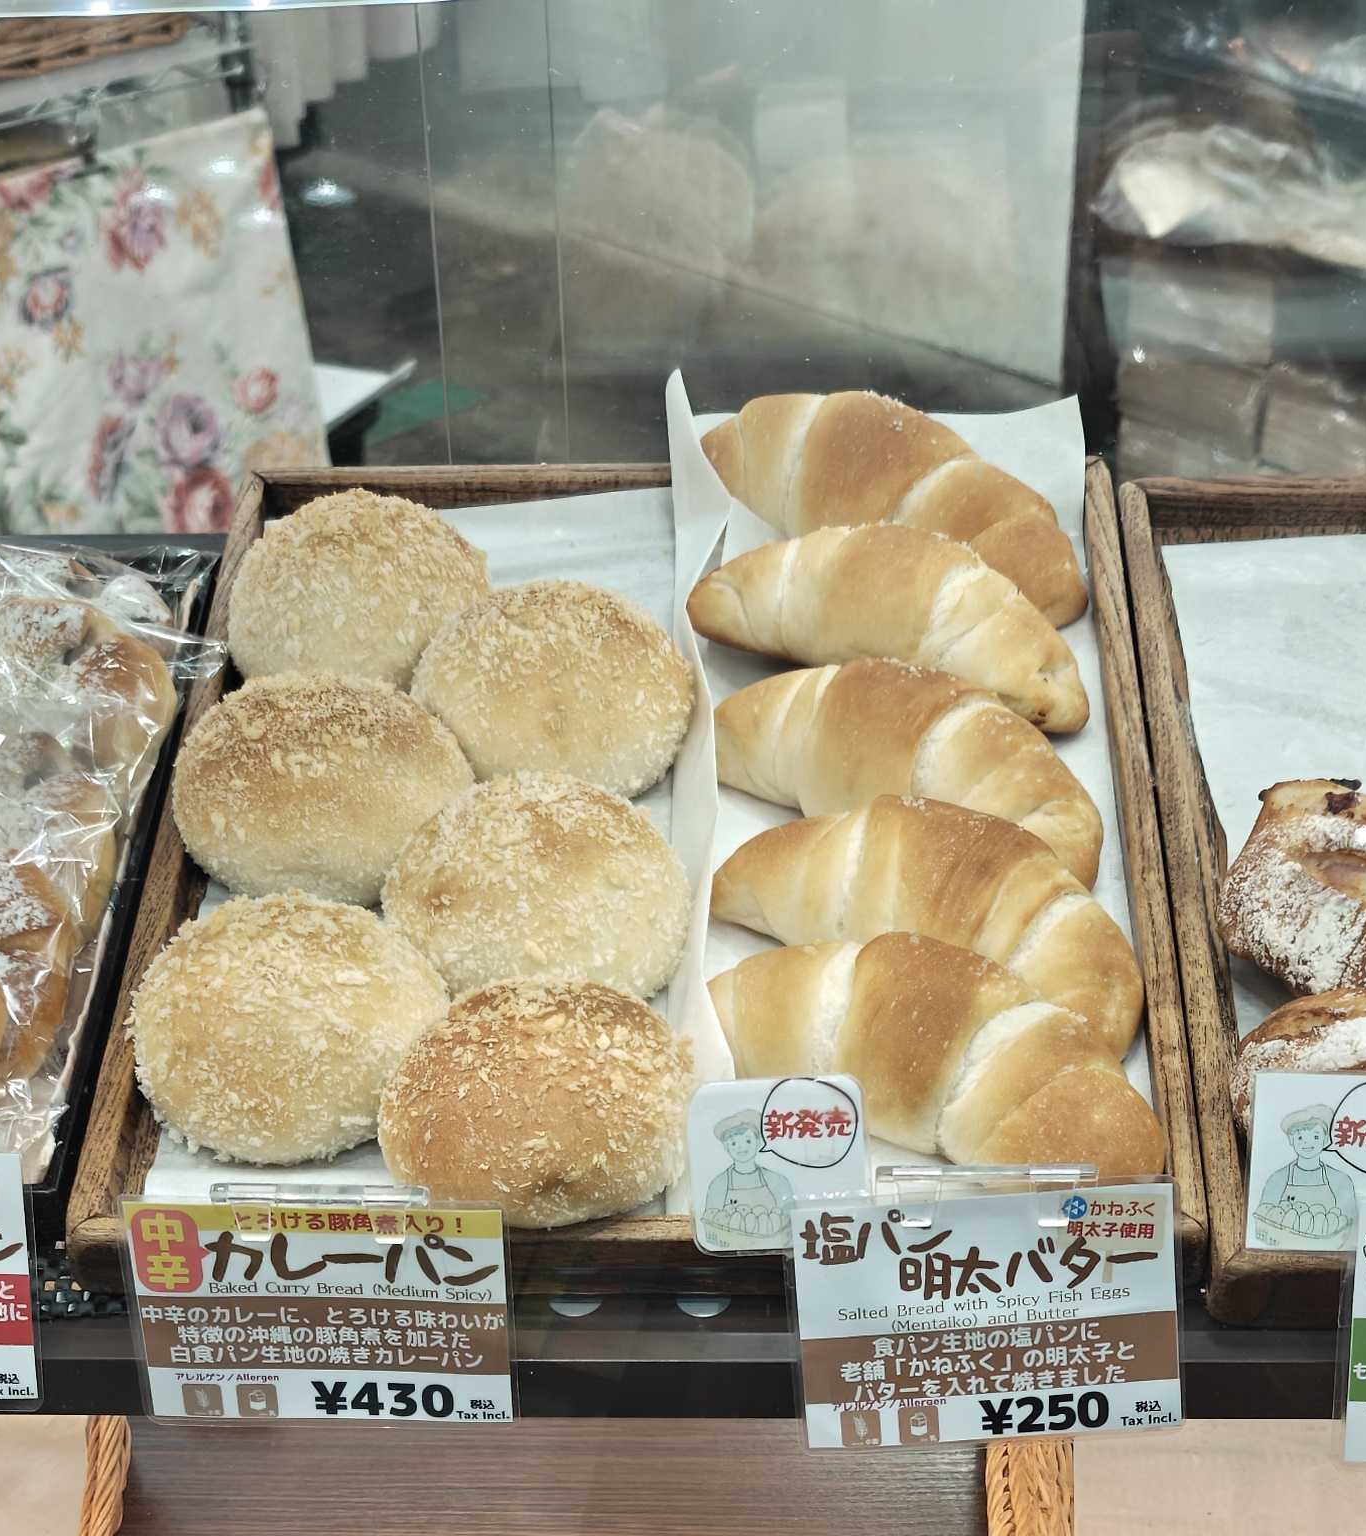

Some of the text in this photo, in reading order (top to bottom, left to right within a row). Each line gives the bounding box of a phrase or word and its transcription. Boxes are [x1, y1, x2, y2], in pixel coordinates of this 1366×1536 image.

[764, 1109, 852, 1139] 新発売
[1089, 1200, 1155, 1217] かねふく
[800, 1209, 953, 1265] 塩パン
[1067, 1221, 1155, 1239] 明太子使用
[140, 1213, 189, 1291] 中辛
[205, 1231, 499, 1286] カレーパン
[900, 1237, 1158, 1300] 明太バター
[209, 1282, 492, 1302] Baked Curry Bread (Medium Spicy)
[838, 1287, 1130, 1321] Salted Bread with Spicy Fish Eggs
[142, 1305, 505, 1331] 中辛のカレーに、とろける味わいが
[892, 1307, 1080, 1333] (Mentaiko) and Butter
[177, 1327, 471, 1350] 特徴の沖縄の豚角煮を加えた
[873, 1322, 1101, 1359] 食パン生地の塩パンに
[170, 1346, 483, 1368] 白食パン生地の焼きカレーパン
[840, 1341, 1135, 1383] 老舗「かねふく」の明太子と
[7, 1385, 34, 1397] Incl.
[854, 1364, 1126, 1403] バターを入れて焼きました
[311, 1381, 454, 1418] ¥430
[981, 1390, 1110, 1435] ¥250
[1135, 1400, 1162, 1414] 税込
[457, 1410, 510, 1421] Tax Incl.
[1121, 1411, 1177, 1427] Tax Incl.
